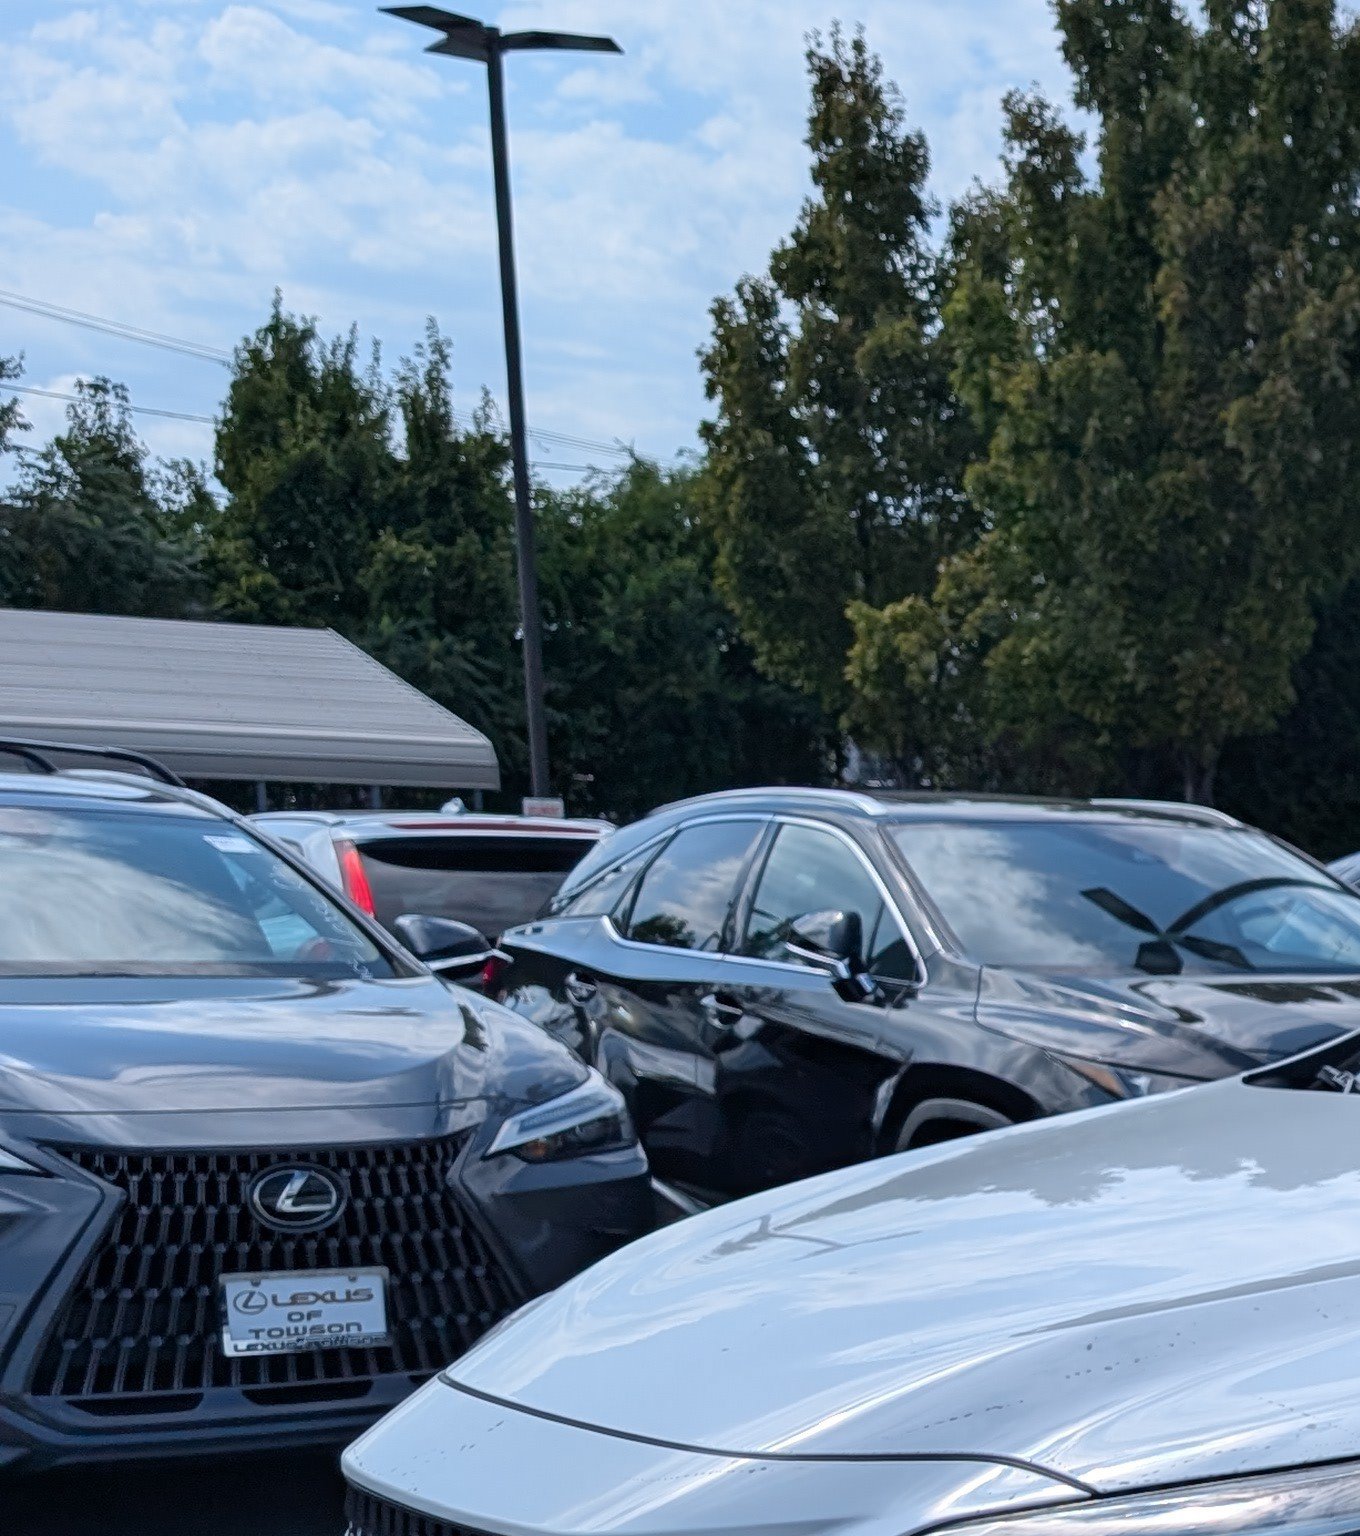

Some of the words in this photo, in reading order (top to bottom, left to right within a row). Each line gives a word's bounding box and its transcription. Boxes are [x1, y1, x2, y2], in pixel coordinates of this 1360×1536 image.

[271, 1288, 375, 1307] LEXUS
[287, 1309, 323, 1323] OF
[248, 1321, 363, 1340] TOWSON
